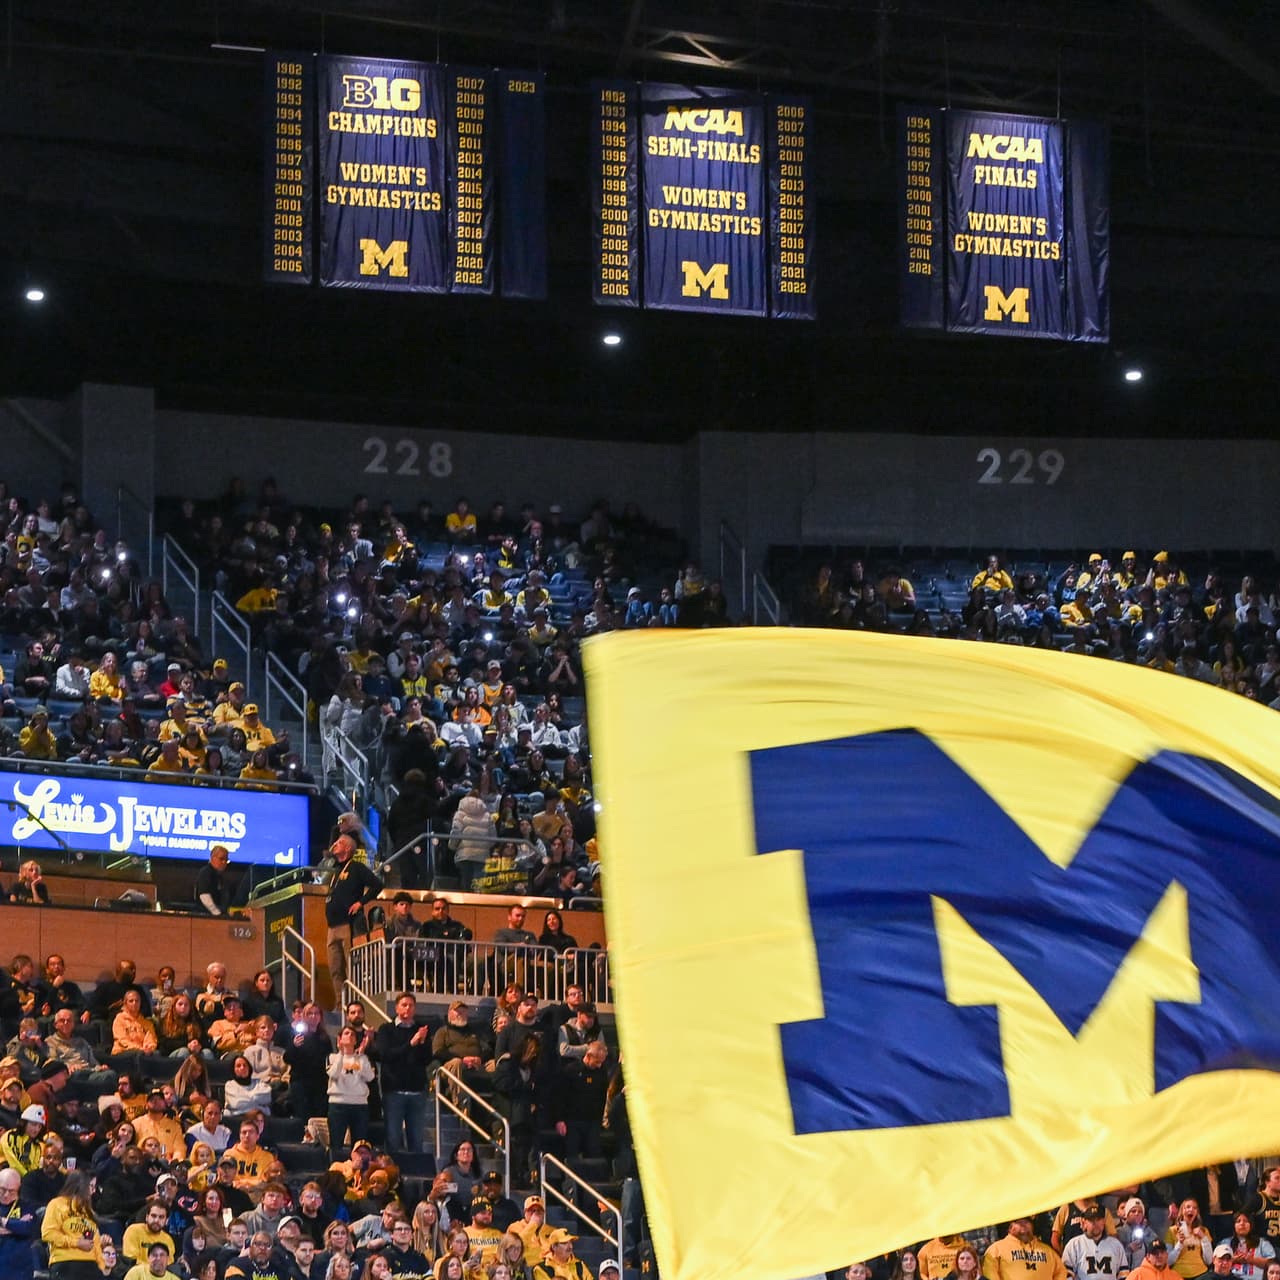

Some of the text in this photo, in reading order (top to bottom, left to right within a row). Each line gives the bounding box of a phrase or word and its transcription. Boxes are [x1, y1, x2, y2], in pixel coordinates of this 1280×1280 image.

[276, 77, 304, 91] 1992
[456, 77, 484, 89] 2007
[507, 80, 536, 94] 2023
[276, 93, 304, 107] 1993
[276, 107, 304, 121] 1994
[455, 106, 485, 120] 2009
[328, 111, 437, 138] CHAMPIONS
[457, 121, 484, 135] 2010
[601, 119, 628, 133] 1994
[664, 106, 743, 136] NCAA
[778, 121, 803, 132] 2007
[275, 121, 304, 137] 1995
[276, 137, 304, 153] 1996
[458, 135, 482, 150] 2011
[601, 134, 628, 149] 1995
[967, 133, 1043, 163] NCAA
[602, 148, 628, 164] 1996
[648, 136, 760, 163] SEMI-FINALS
[779, 150, 804, 162] 2010
[276, 153, 304, 167] 1997
[457, 151, 484, 166] 2013
[276, 167, 304, 183] 1999
[340, 162, 426, 186] WOMEN'S
[457, 165, 484, 180] 2014
[601, 163, 628, 178] 1997
[780, 164, 802, 176] 2011
[975, 165, 1037, 189] FINALS
[274, 182, 305, 198] 2000
[457, 180, 483, 195] 2015
[602, 178, 628, 193] 1998
[780, 177, 805, 192] 2013
[274, 197, 303, 213] 2001
[327, 185, 441, 211] GYMNASTICS
[457, 195, 484, 210] 2016
[602, 193, 628, 208] 1999
[662, 185, 747, 211] WOMEN'S
[779, 192, 805, 206] 2014
[273, 213, 305, 229] 2002
[457, 210, 483, 224] 2017
[600, 207, 630, 223] 2000
[649, 208, 762, 235] GYMNASTICS
[779, 207, 804, 221] 2015
[602, 222, 628, 237] 2001
[780, 220, 804, 235] 2017
[968, 212, 1046, 236] WOMEN'S
[273, 228, 305, 243] 2003
[457, 225, 484, 240] 2018
[273, 242, 304, 258] 2004
[456, 240, 484, 255] 2019
[601, 237, 630, 253] 2002
[780, 236, 805, 250] 2018
[954, 234, 1060, 260] GYMNASTICS
[359, 238, 409, 277] M
[456, 255, 485, 270] 2020
[600, 252, 630, 267] 2003
[780, 251, 805, 265] 2019
[273, 258, 304, 273] 2005
[781, 266, 806, 279] 2021
[455, 270, 484, 285] 2022
[601, 267, 631, 281] 2004
[681, 261, 729, 300] M
[601, 282, 630, 297] 2005
[780, 280, 808, 294] 2022
[984, 285, 1030, 323] M
[362, 437, 454, 479] 228
[975, 446, 1066, 487] 229
[110, 796, 246, 851] JEWELERS
[233, 926, 252, 938] 126
[1026, 1262, 1036, 1270] M
[1086, 1256, 1113, 1275] M
